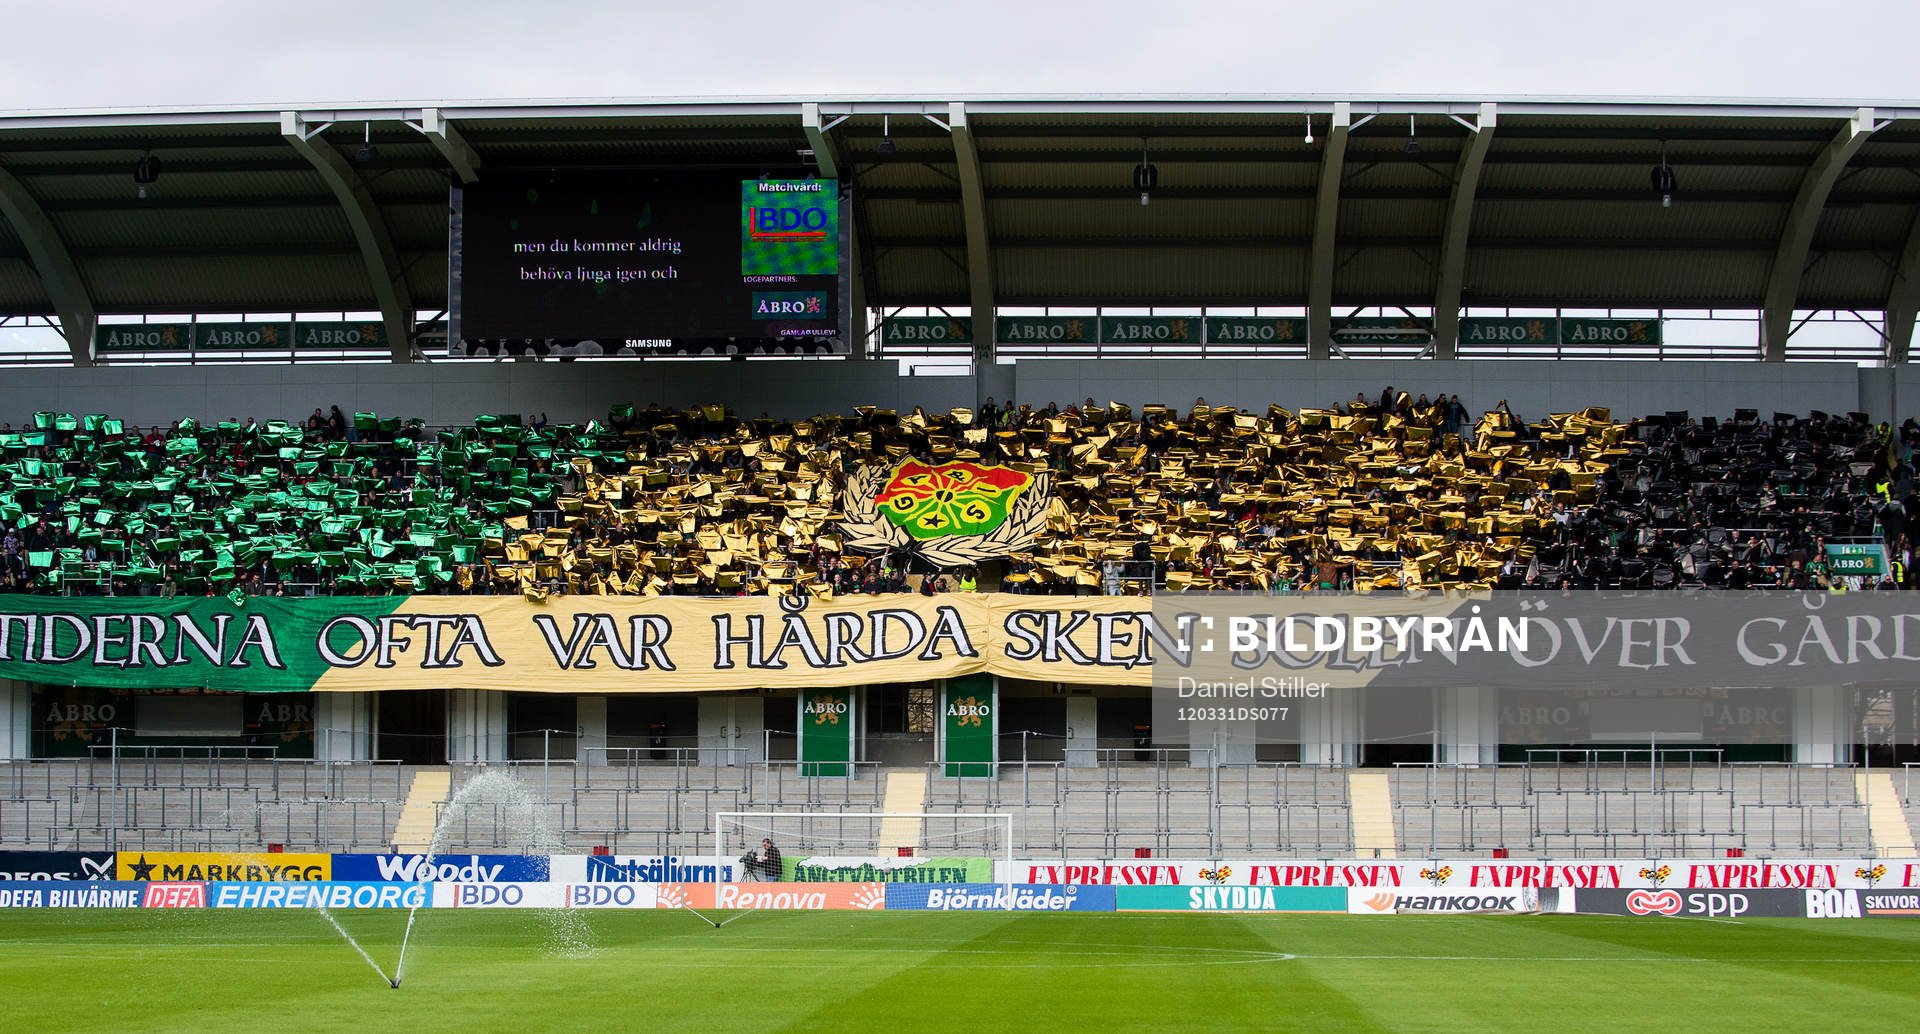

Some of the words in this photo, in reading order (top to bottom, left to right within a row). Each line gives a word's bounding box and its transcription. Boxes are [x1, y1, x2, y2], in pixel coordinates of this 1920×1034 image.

[758, 182, 822, 192] Matchvärd:
[760, 207, 827, 230] BDO
[514, 242, 546, 252] men
[550, 239, 569, 252] du
[573, 239, 635, 252] kommer
[639, 238, 682, 255] aldrig
[520, 266, 572, 280] behöva
[577, 266, 612, 283] ljuga
[617, 267, 647, 283] igen
[651, 265, 678, 280] och
[757, 299, 805, 313] ÅBRO
[107, 331, 161, 346] ÅBRO
[206, 329, 261, 345] ÅBRO
[305, 328, 361, 344] ÅBRO
[889, 322, 946, 339] ÅBRO
[1007, 323, 1065, 339] ÅBRO
[1112, 323, 1170, 339] ÅBRO
[1218, 323, 1275, 339] ÅBRO
[1469, 324, 1526, 341] ÅBRO
[1572, 324, 1628, 341] ÅBRO
[625, 339, 672, 348] SAMSUNG
[1833, 558, 1864, 569] ÅBRO
[316, 612, 505, 669] OFTA
[533, 613, 676, 671] VAR
[712, 596, 979, 670] HÅRDA
[1003, 609, 1196, 670] SKEN
[1506, 599, 1697, 671] ÖVER
[47, 703, 116, 721] ÅBRO
[804, 702, 847, 714] ÅBRO
[947, 703, 989, 716] ÅBRO
[163, 864, 322, 881] MARKBYGG
[376, 855, 504, 882] Woody
[1028, 865, 1183, 885] EXPRESSEN
[1249, 865, 1405, 887] EXPRESSEN
[1470, 864, 1624, 888] EXPRESSEN
[1688, 864, 1840, 888] EXPRESSEN
[0, 889, 43, 908] DEFA
[49, 885, 139, 908] BILVÄRME
[150, 887, 201, 908] DEFA
[216, 884, 427, 908] EHRENBORG
[462, 884, 523, 906] BDO
[573, 884, 636, 906] BDO
[719, 885, 826, 909] Renova
[927, 888, 1076, 911] Björnkläder
[1189, 886, 1276, 909] SKYDDA
[1806, 889, 1861, 918] BOA
